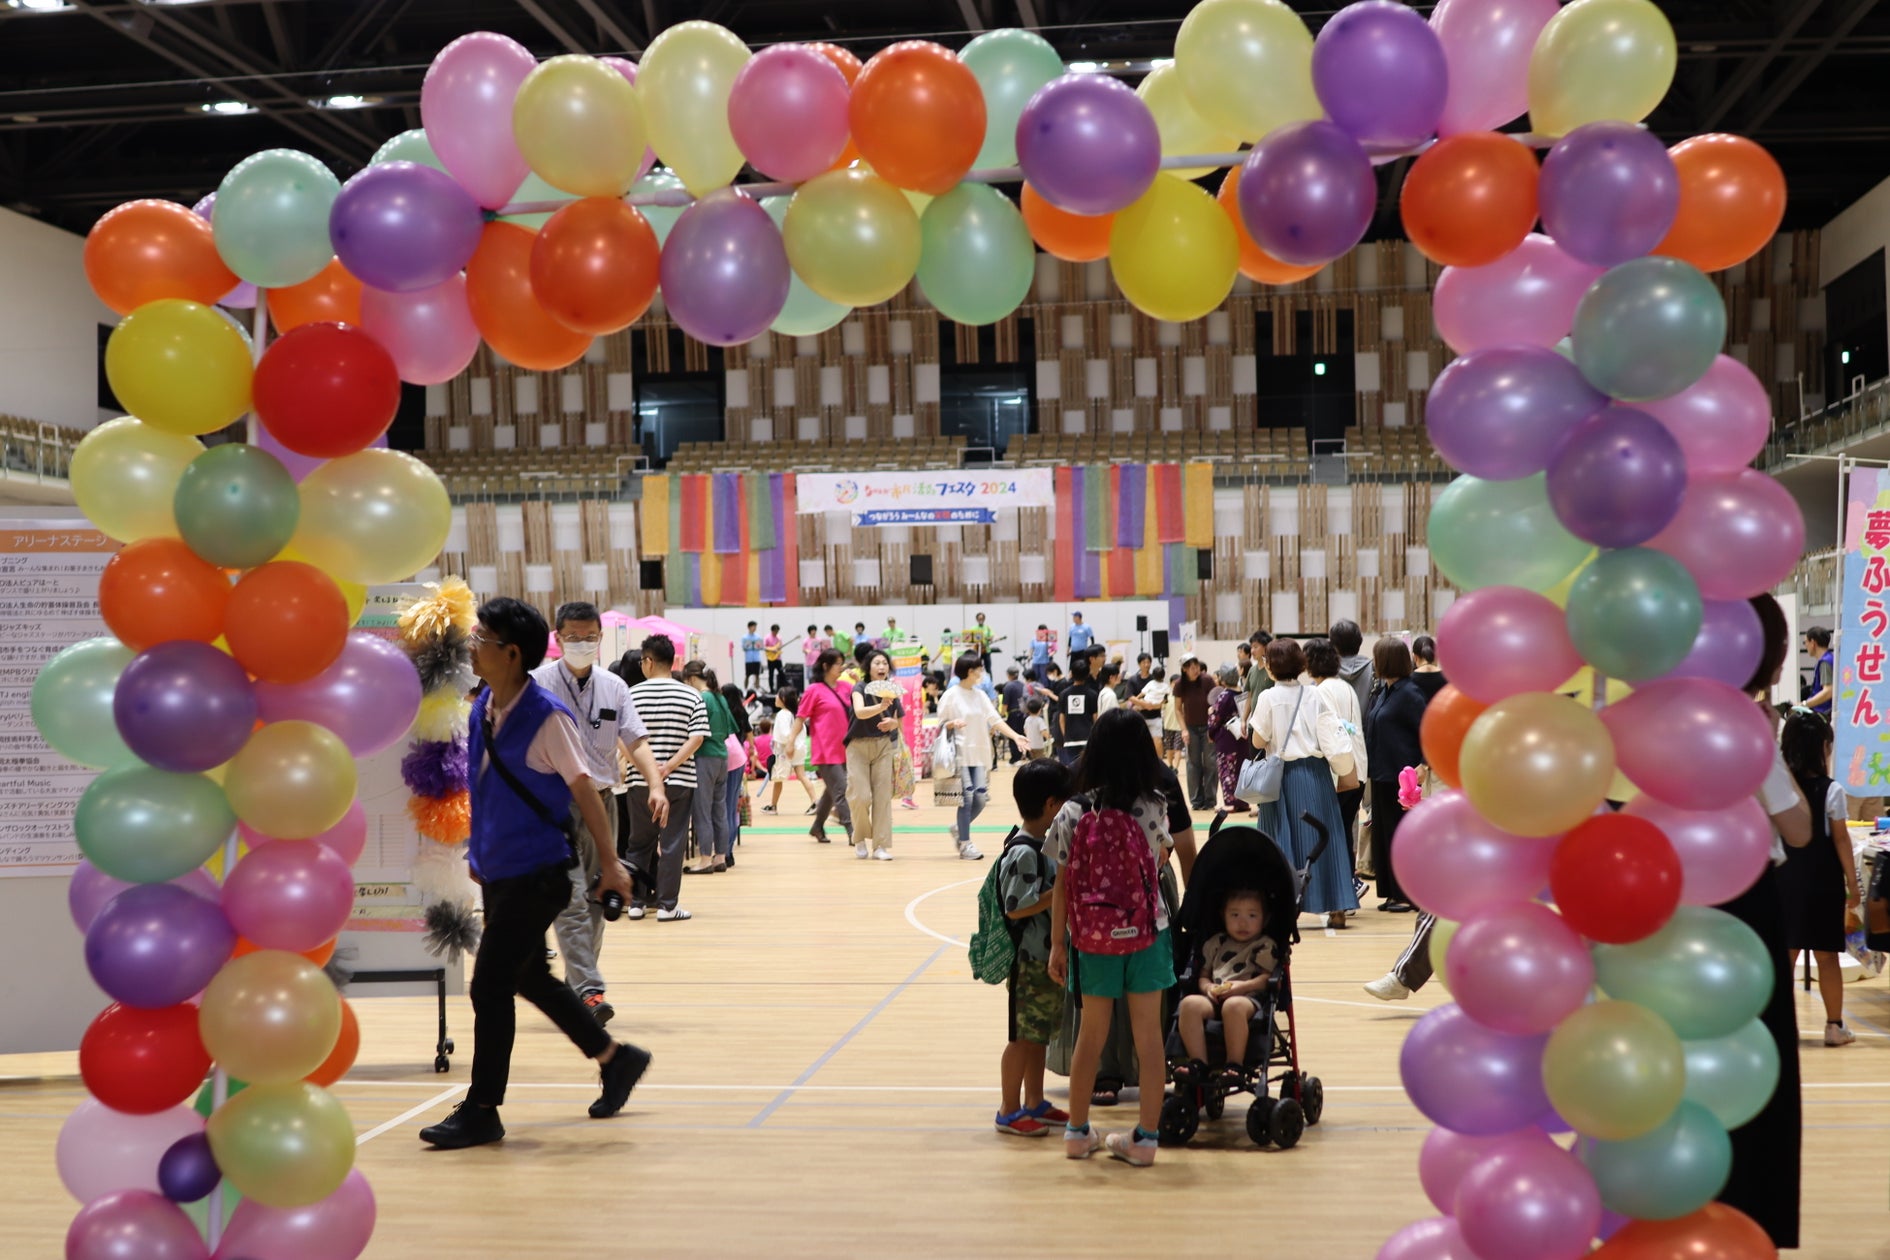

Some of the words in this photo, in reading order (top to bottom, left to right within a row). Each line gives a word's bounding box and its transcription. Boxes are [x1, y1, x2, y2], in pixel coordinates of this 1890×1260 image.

[981, 482, 1016, 494] 2024
[13, 534, 107, 547] アリーナステージ
[1853, 510, 1890, 726] 夢ふうせん
